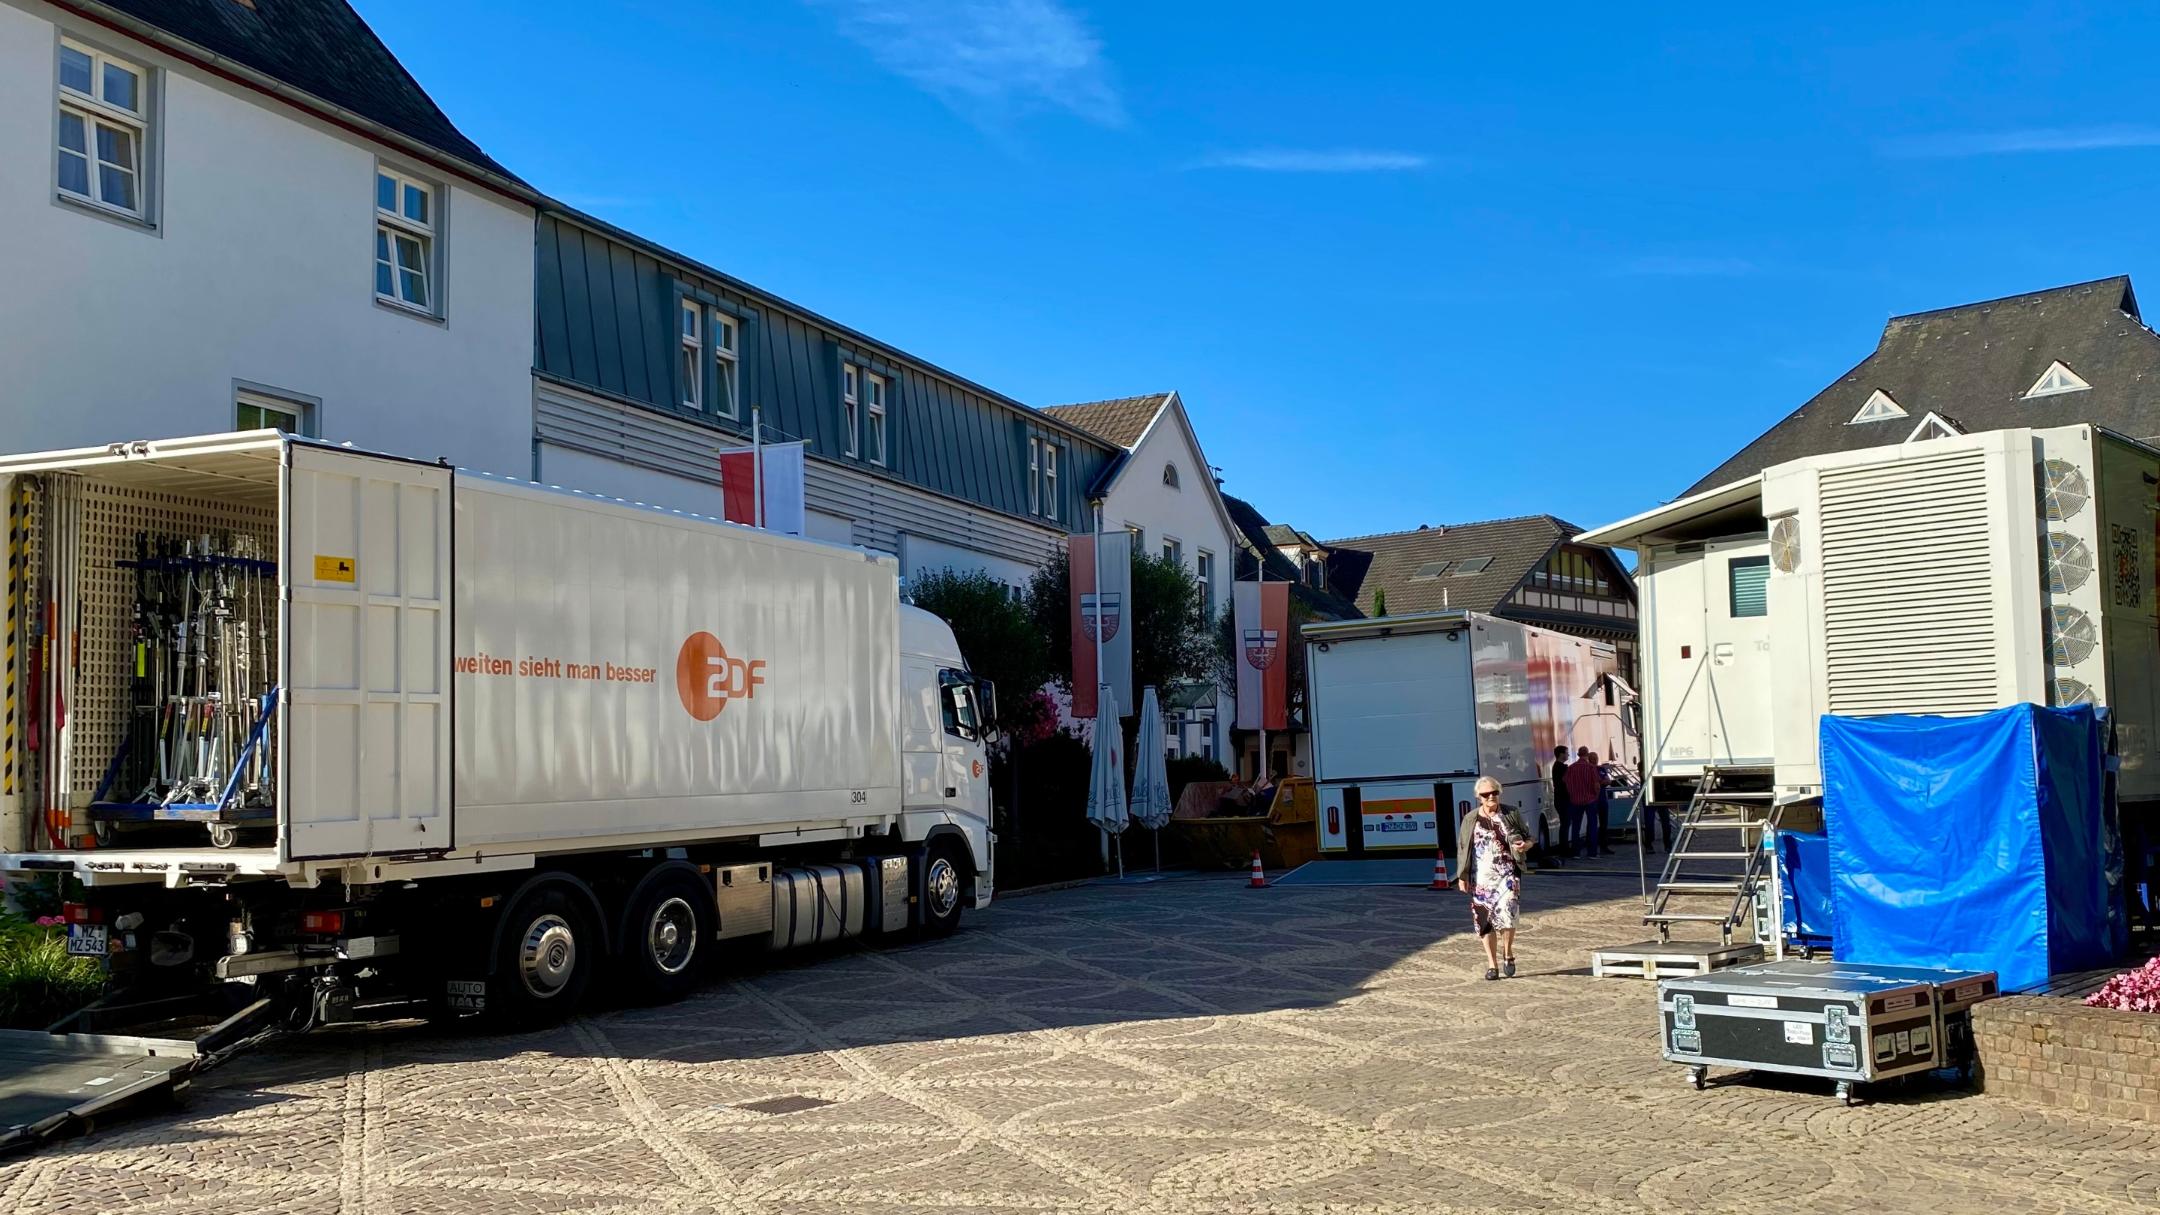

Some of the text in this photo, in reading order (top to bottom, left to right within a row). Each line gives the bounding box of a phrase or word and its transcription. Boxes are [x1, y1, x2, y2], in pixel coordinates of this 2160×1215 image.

[519, 656, 561, 678] sieht
[567, 662, 601, 680] man
[606, 661, 657, 683] besser
[706, 656, 766, 699] ZDF
[851, 791, 866, 803] 304
[81, 925, 95, 938] MZ
[70, 939, 104, 952] MZ 543
[449, 982, 483, 994] AUTO
